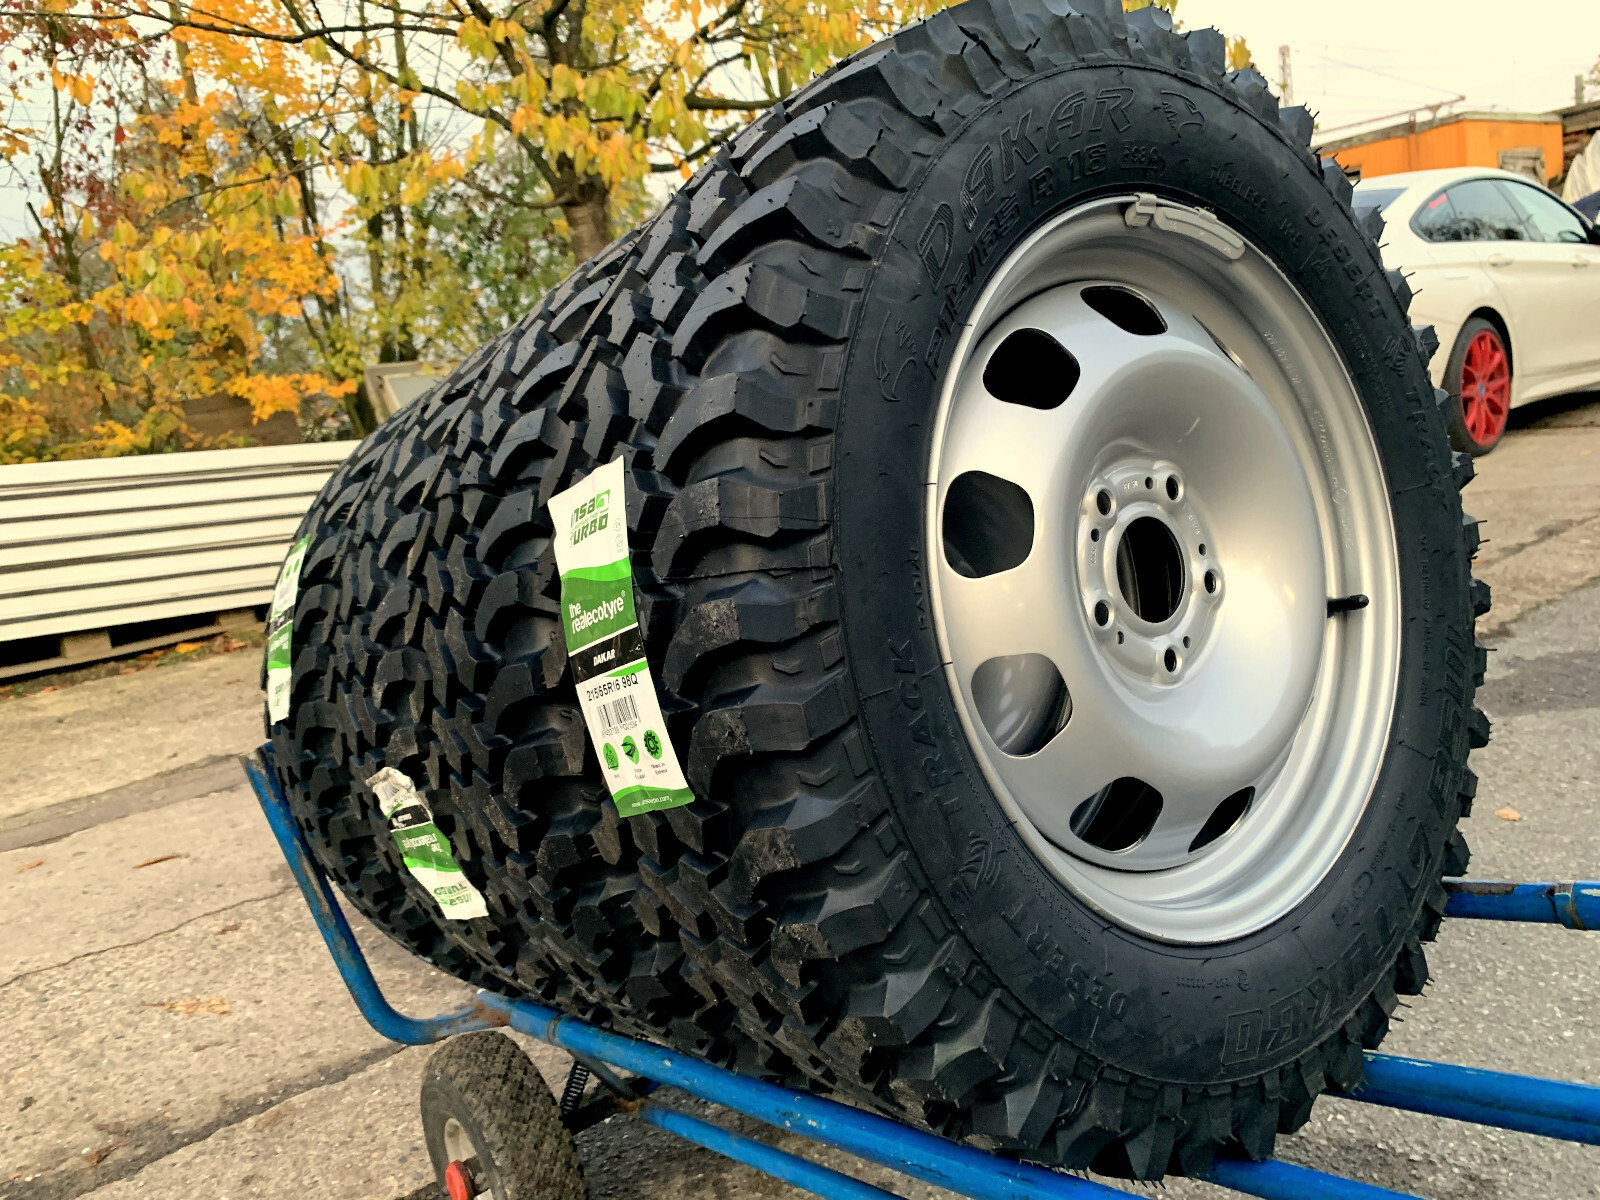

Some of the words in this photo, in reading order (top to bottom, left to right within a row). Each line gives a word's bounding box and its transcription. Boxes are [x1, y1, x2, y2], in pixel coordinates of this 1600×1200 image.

[1066, 142, 1108, 183] 16
[917, 86, 1135, 293] DAKAR
[1303, 202, 1389, 320] DESERT
[570, 513, 609, 548] TURBO
[568, 602, 582, 618] the
[572, 596, 625, 634] realecotyre
[593, 649, 616, 666] DAKAR
[622, 673, 639, 689] 98Q
[887, 638, 963, 829] TRACK
[1000, 903, 1131, 1022] DESERT
